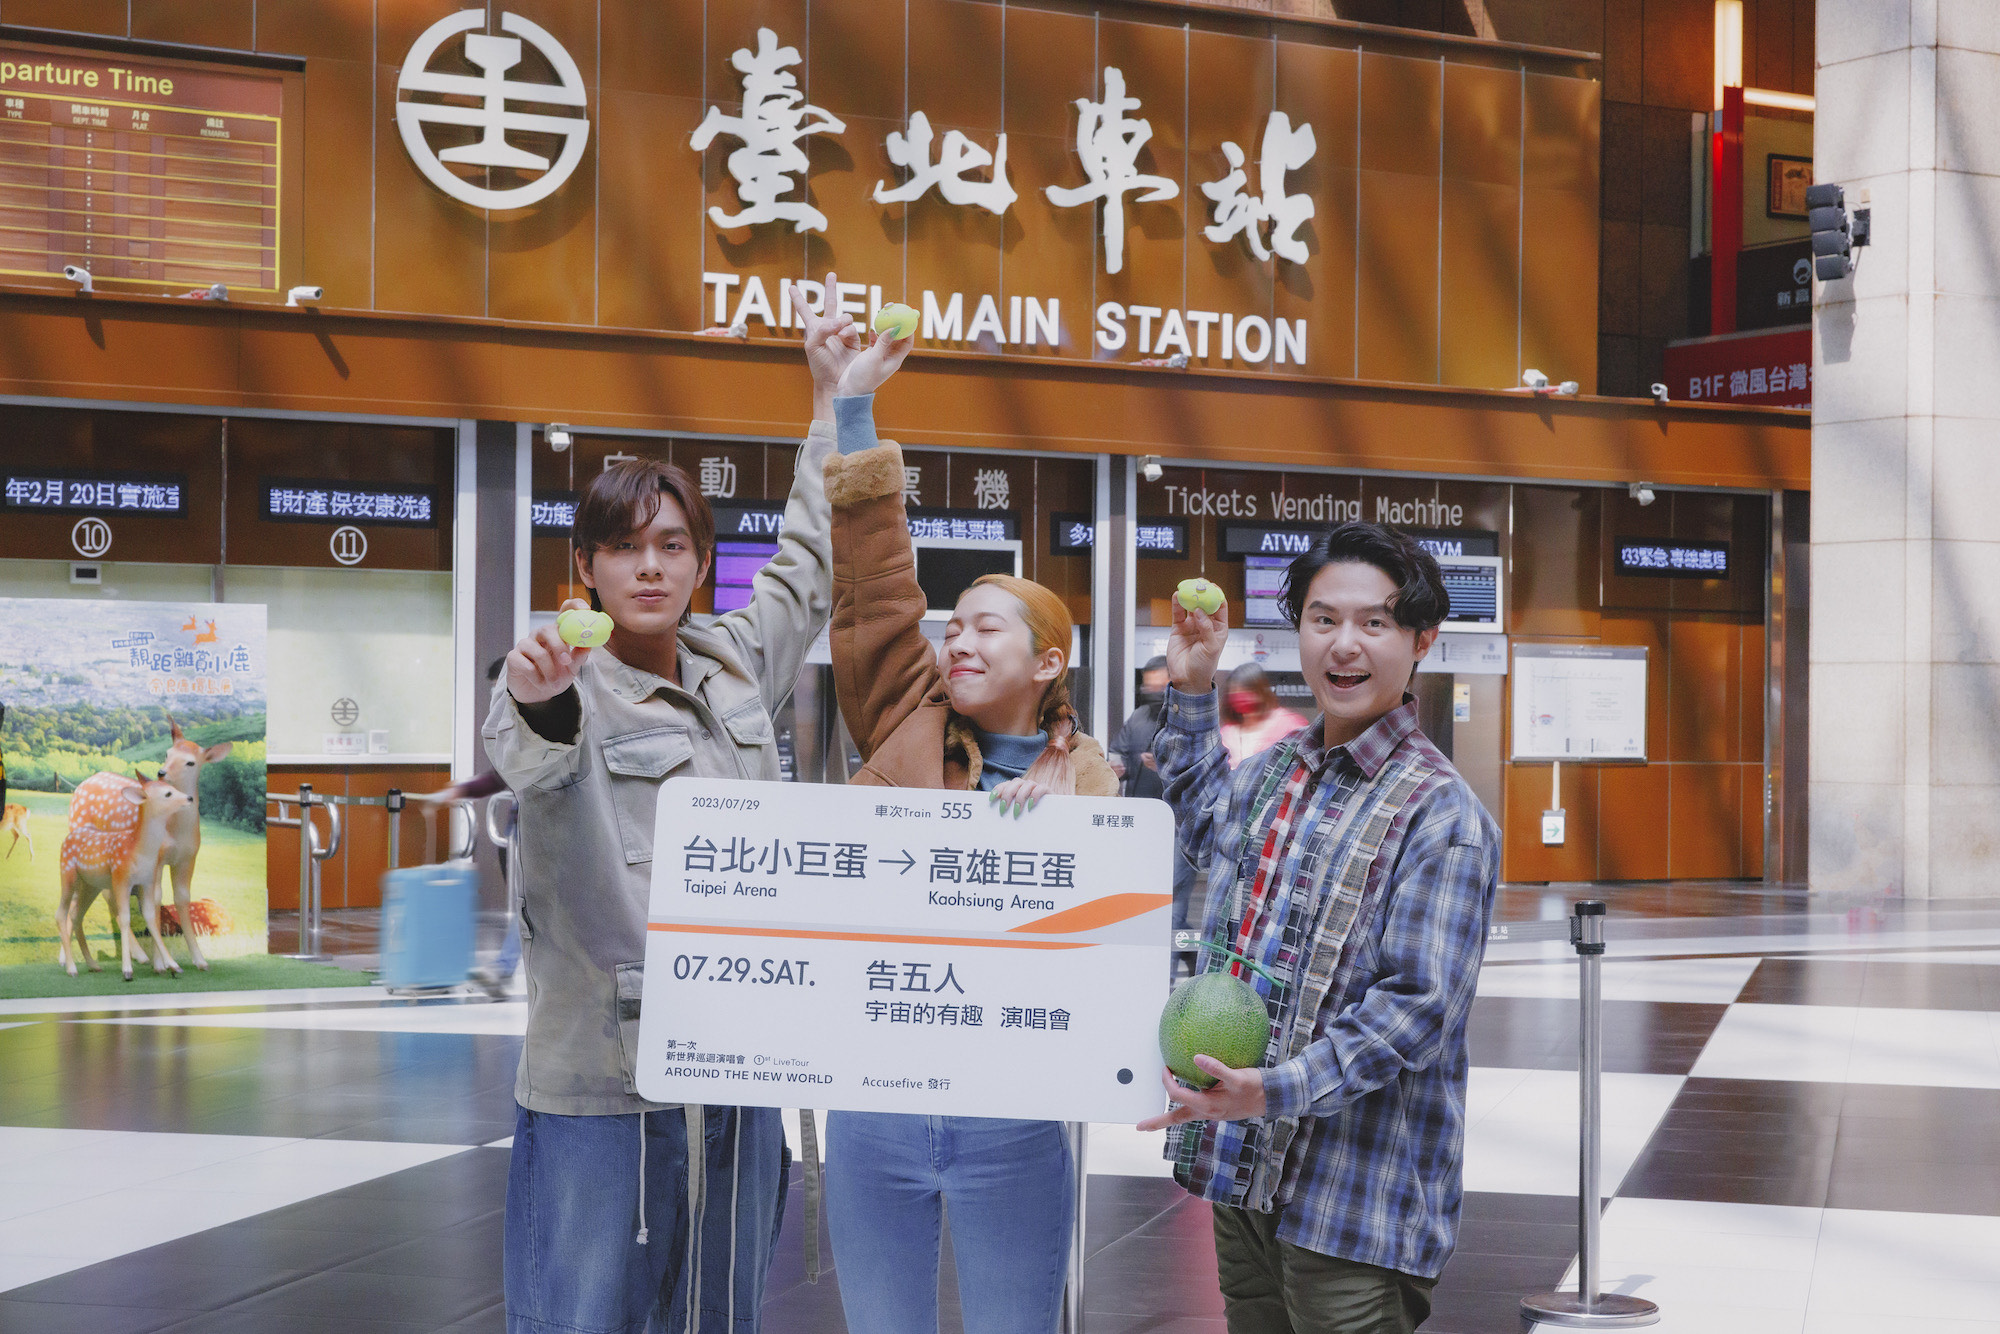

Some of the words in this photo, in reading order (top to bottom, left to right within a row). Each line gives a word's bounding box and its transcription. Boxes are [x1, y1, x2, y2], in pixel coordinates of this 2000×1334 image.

[0, 61, 99, 88] parture
[108, 67, 174, 95] Time
[7, 110, 23, 119] TYPE
[200, 128, 230, 139] REMARKS
[690, 27, 1317, 274] 臺北車站
[703, 272, 882, 334] TAIPEI
[922, 290, 1060, 347] MAIN
[1095, 301, 1307, 365] STATION
[1689, 374, 1725, 399] B1F
[1730, 363, 1812, 398] 微風台灣
[1164, 485, 1257, 518] Tickets
[1271, 490, 1362, 523] Vending
[1376, 495, 1463, 527] Machine
[1260, 532, 1310, 553] ATVM
[691, 796, 760, 811] 2023/07/29
[940, 802, 973, 820] 555
[1091, 814, 1135, 829] 單程票
[683, 835, 868, 880] 台北小巨蛋
[928, 847, 1076, 889] 高雄巨蛋
[684, 878, 727, 898] Taipei
[733, 880, 778, 898] Arena
[928, 890, 1004, 911] Kaohsiung
[1010, 894, 1055, 911] Arena
[673, 954, 816, 987] 07.29.SAT.
[865, 959, 966, 995] 告五人
[864, 1000, 983, 1027] 宇宙的有趣
[1000, 1005, 1071, 1031] 演唱會
[667, 1039, 697, 1050] 第一次
[664, 1066, 720, 1079] AROUND
[724, 1069, 749, 1080] THE
[753, 1070, 782, 1082] NEW
[786, 1073, 833, 1084] WORLD
[862, 1076, 923, 1090] Accusefive
[928, 1078, 951, 1091] 發行
